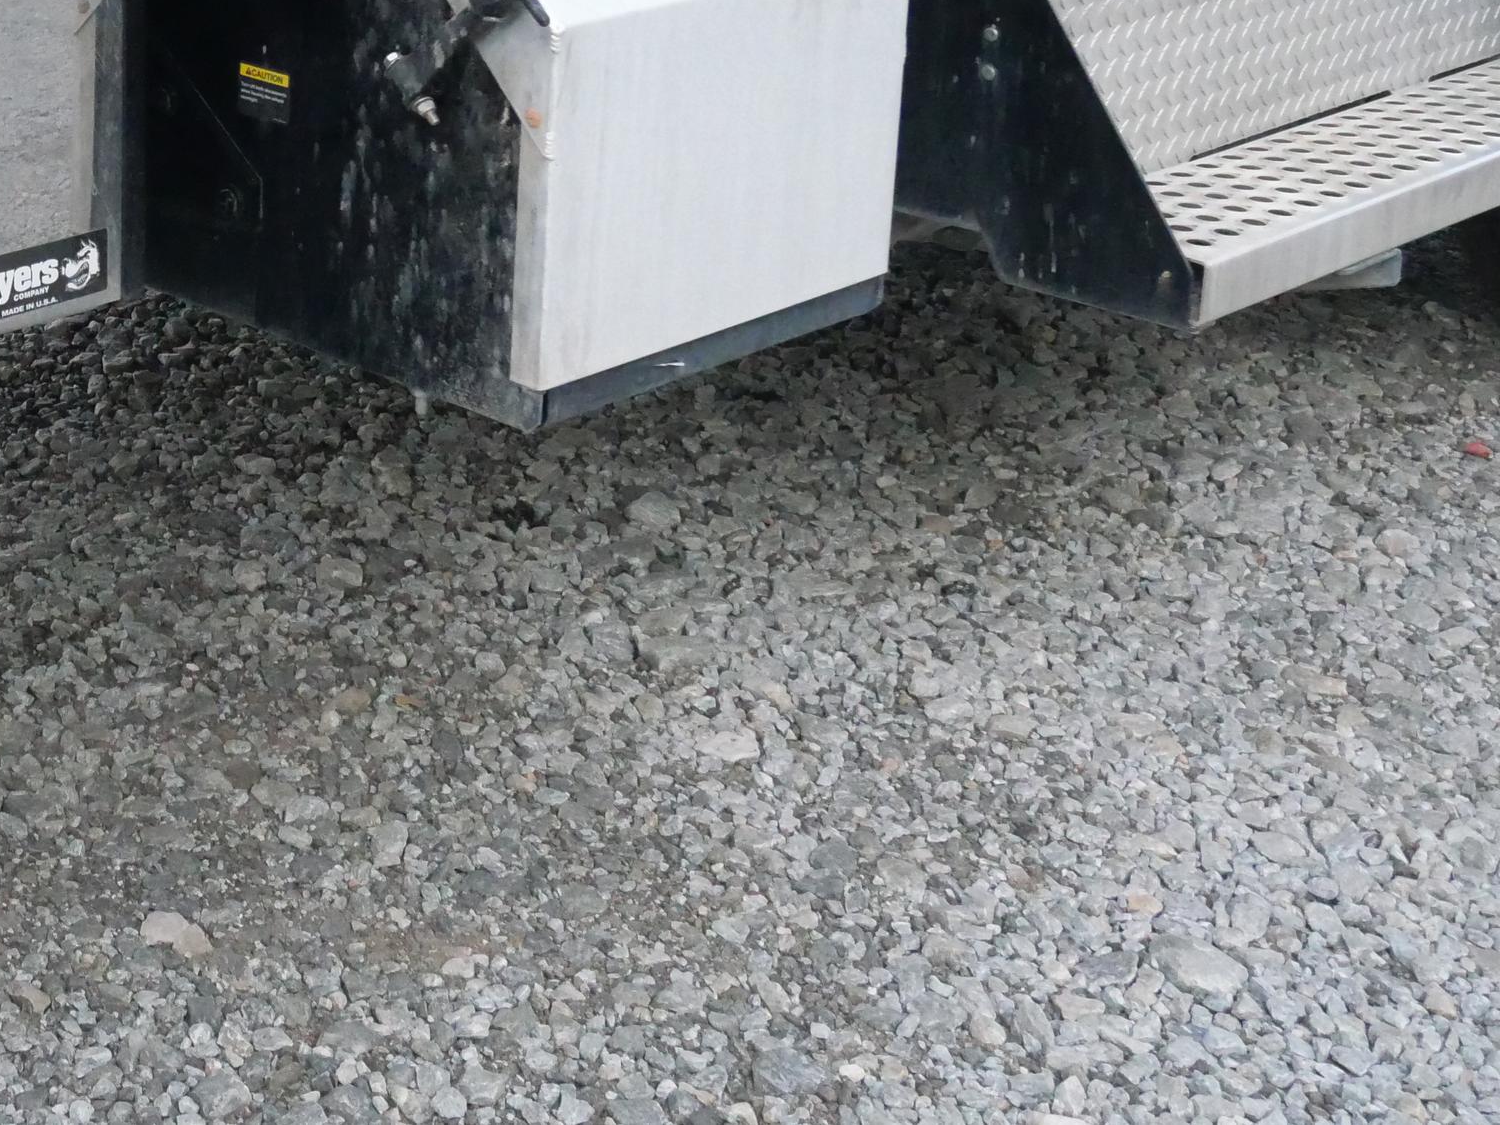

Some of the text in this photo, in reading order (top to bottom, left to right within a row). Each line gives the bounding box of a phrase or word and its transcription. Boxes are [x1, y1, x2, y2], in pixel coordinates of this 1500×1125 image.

[252, 69, 284, 85] CAUTION
[13, 285, 50, 302] COMPANY
[1, 296, 59, 318] MADE IN U.S.A.
